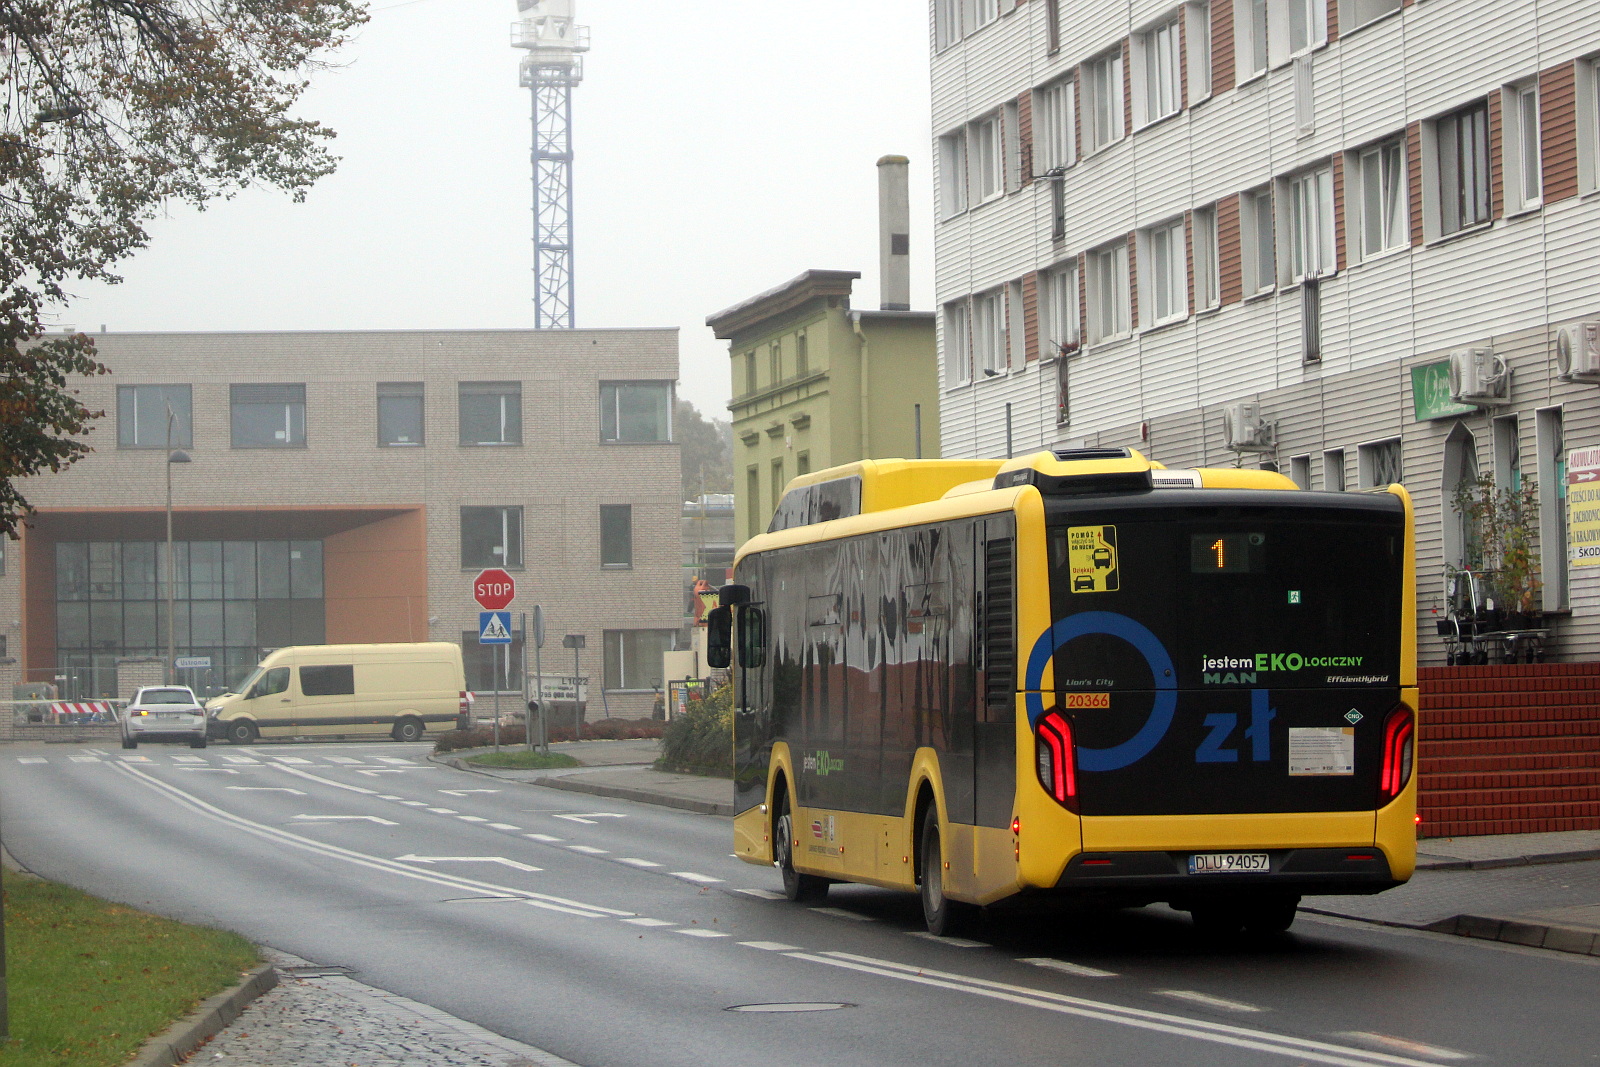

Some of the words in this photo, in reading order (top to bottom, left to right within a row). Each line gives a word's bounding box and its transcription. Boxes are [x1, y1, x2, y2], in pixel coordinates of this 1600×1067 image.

[1570, 449, 1600, 468] AKUMULATO
[1211, 539, 1223, 568] 1
[478, 583, 511, 596] STOP
[1202, 655, 1253, 672] jestem
[1096, 679, 1114, 687] City
[1204, 672, 1257, 684] MAN
[1327, 675, 1389, 683] EfficientHybrid
[1068, 694, 1108, 707] 20366
[1195, 689, 1277, 763] zł
[1196, 856, 1222, 869] DLU
[1227, 855, 1267, 869] 94057
